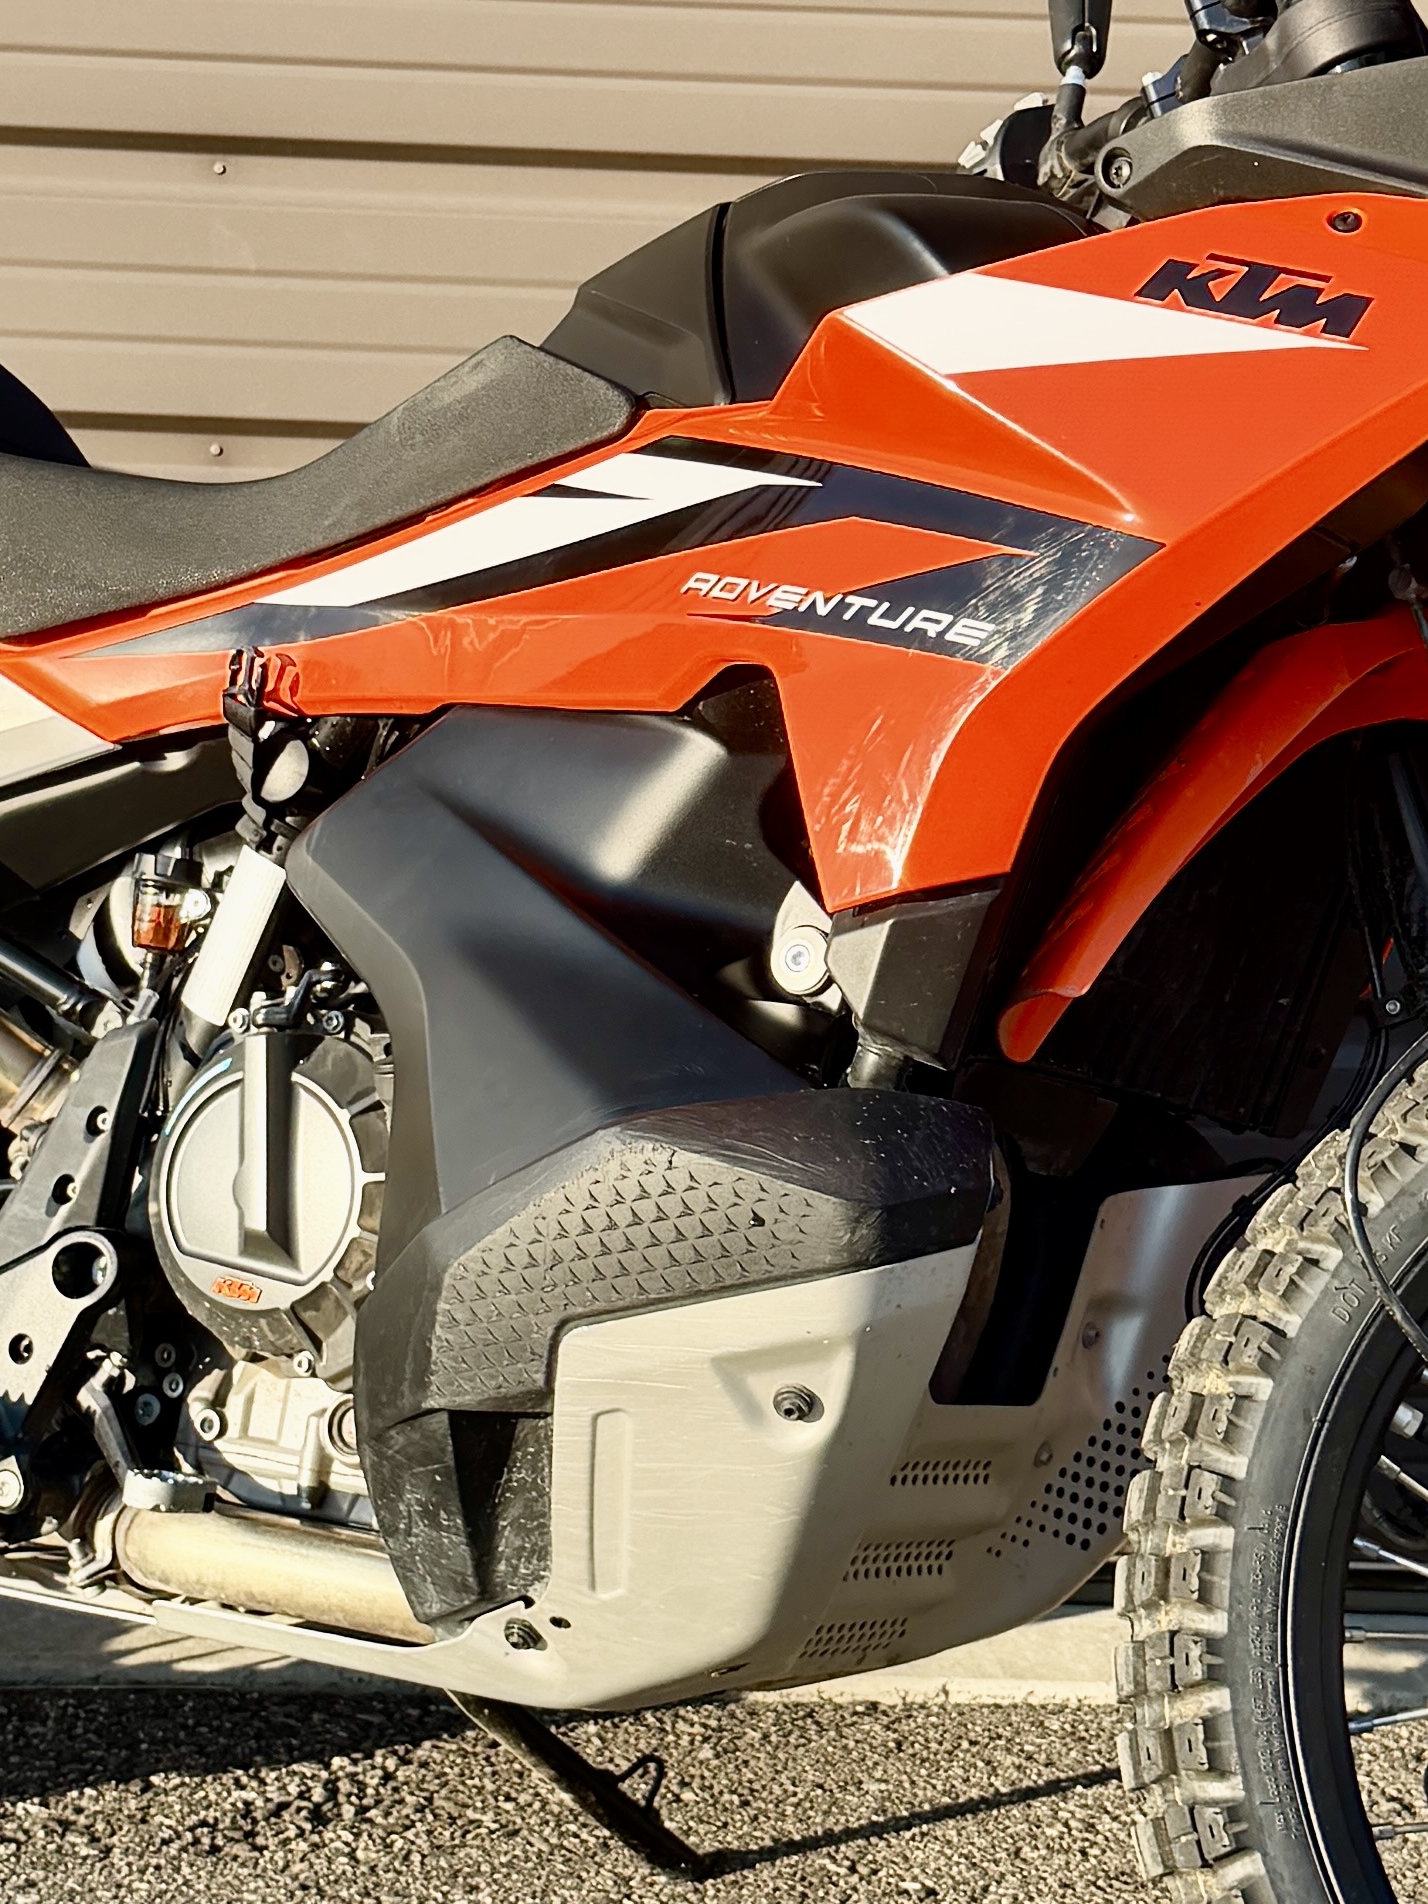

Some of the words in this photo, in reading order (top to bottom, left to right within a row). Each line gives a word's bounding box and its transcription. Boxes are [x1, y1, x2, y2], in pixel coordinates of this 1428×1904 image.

[1134, 253, 1374, 338] KTM
[680, 571, 995, 646] ADVENTURE
[1331, 1277, 1367, 1323] DOT
